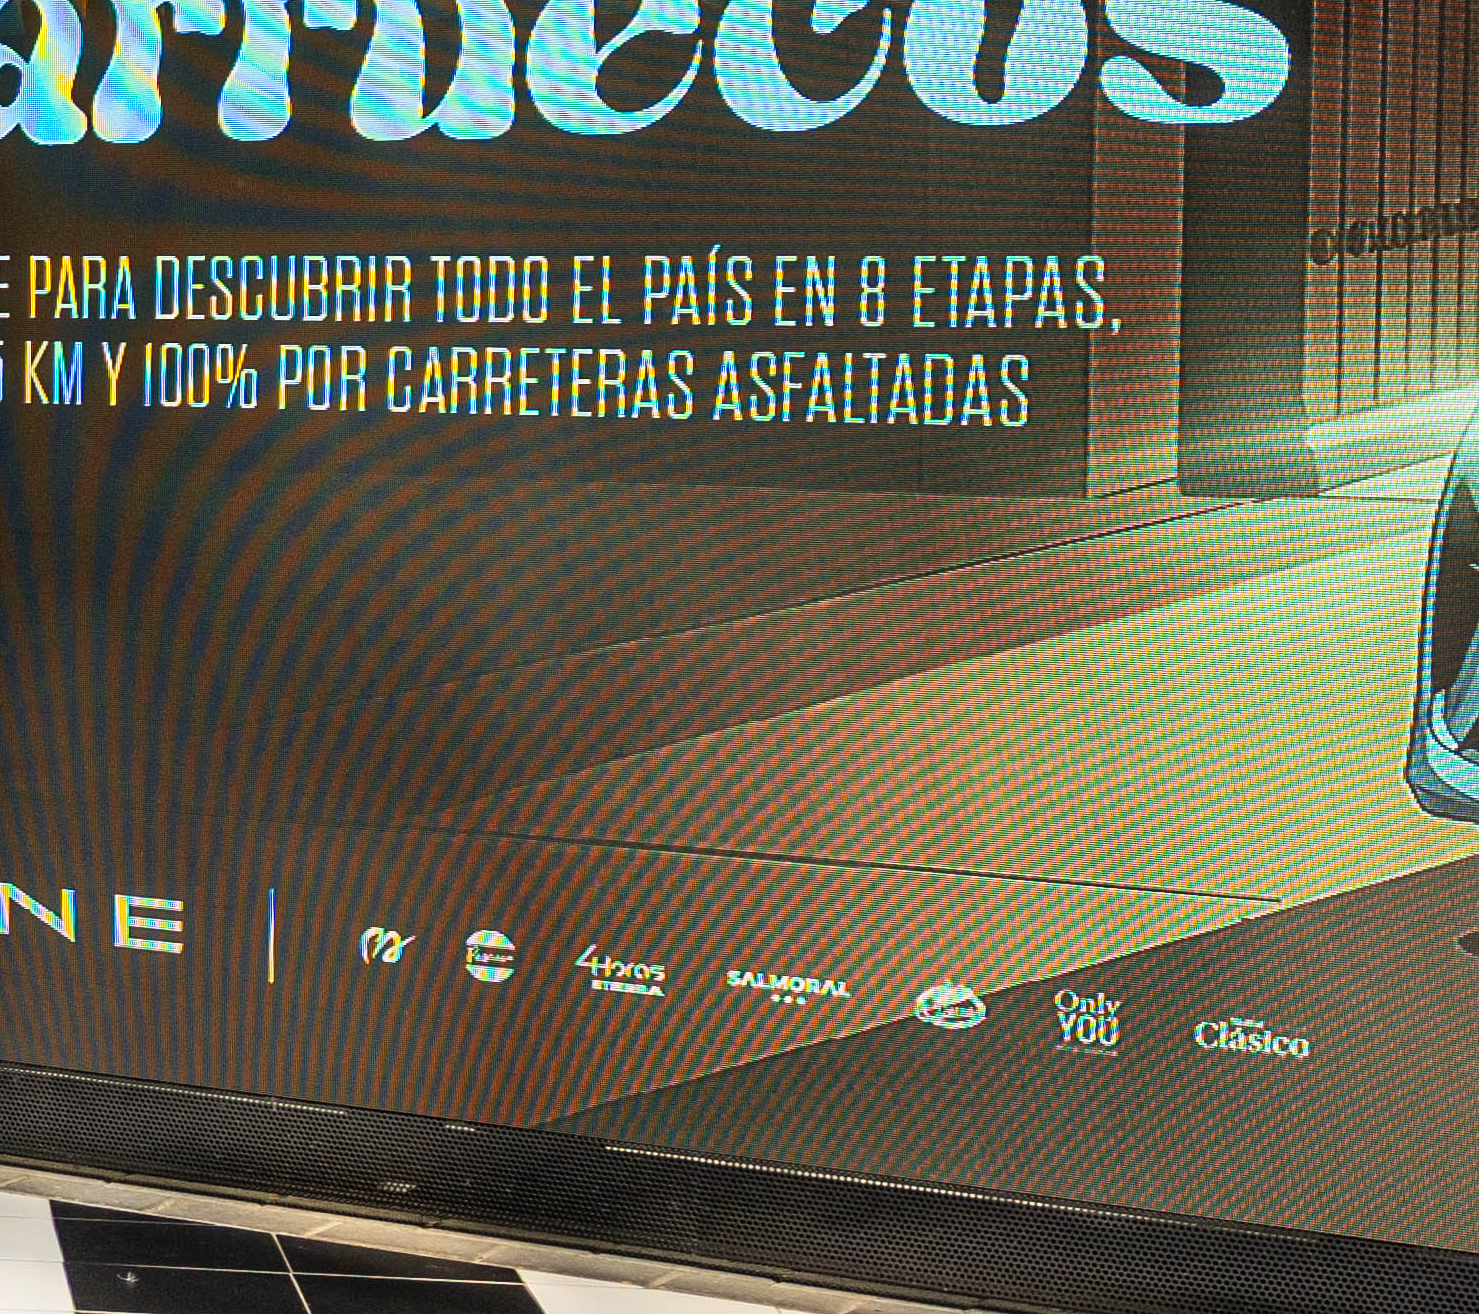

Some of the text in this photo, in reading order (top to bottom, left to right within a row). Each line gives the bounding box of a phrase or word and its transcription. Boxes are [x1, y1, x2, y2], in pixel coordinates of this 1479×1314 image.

[29, 255, 136, 320] PARA
[154, 255, 412, 322] DESCUBRIR
[430, 255, 549, 324] TODO
[572, 255, 622, 325] EL
[643, 243, 753, 326] PAÍS
[774, 255, 836, 327] EN
[859, 255, 886, 328] 8
[912, 255, 1122, 335] ETAPAS,
[24, 340, 84, 406] KM
[101, 341, 127, 407] Y
[144, 342, 259, 409] 100%
[277, 344, 367, 412] POR
[386, 345, 695, 420] CARRETERAS
[712, 350, 1030, 427] ASFALTADAS
[725, 969, 852, 999] SALMORAL
[1053, 989, 1123, 1021] Only
[1056, 1011, 1122, 1047] YOU
[1193, 1019, 1312, 1058] Clásico
